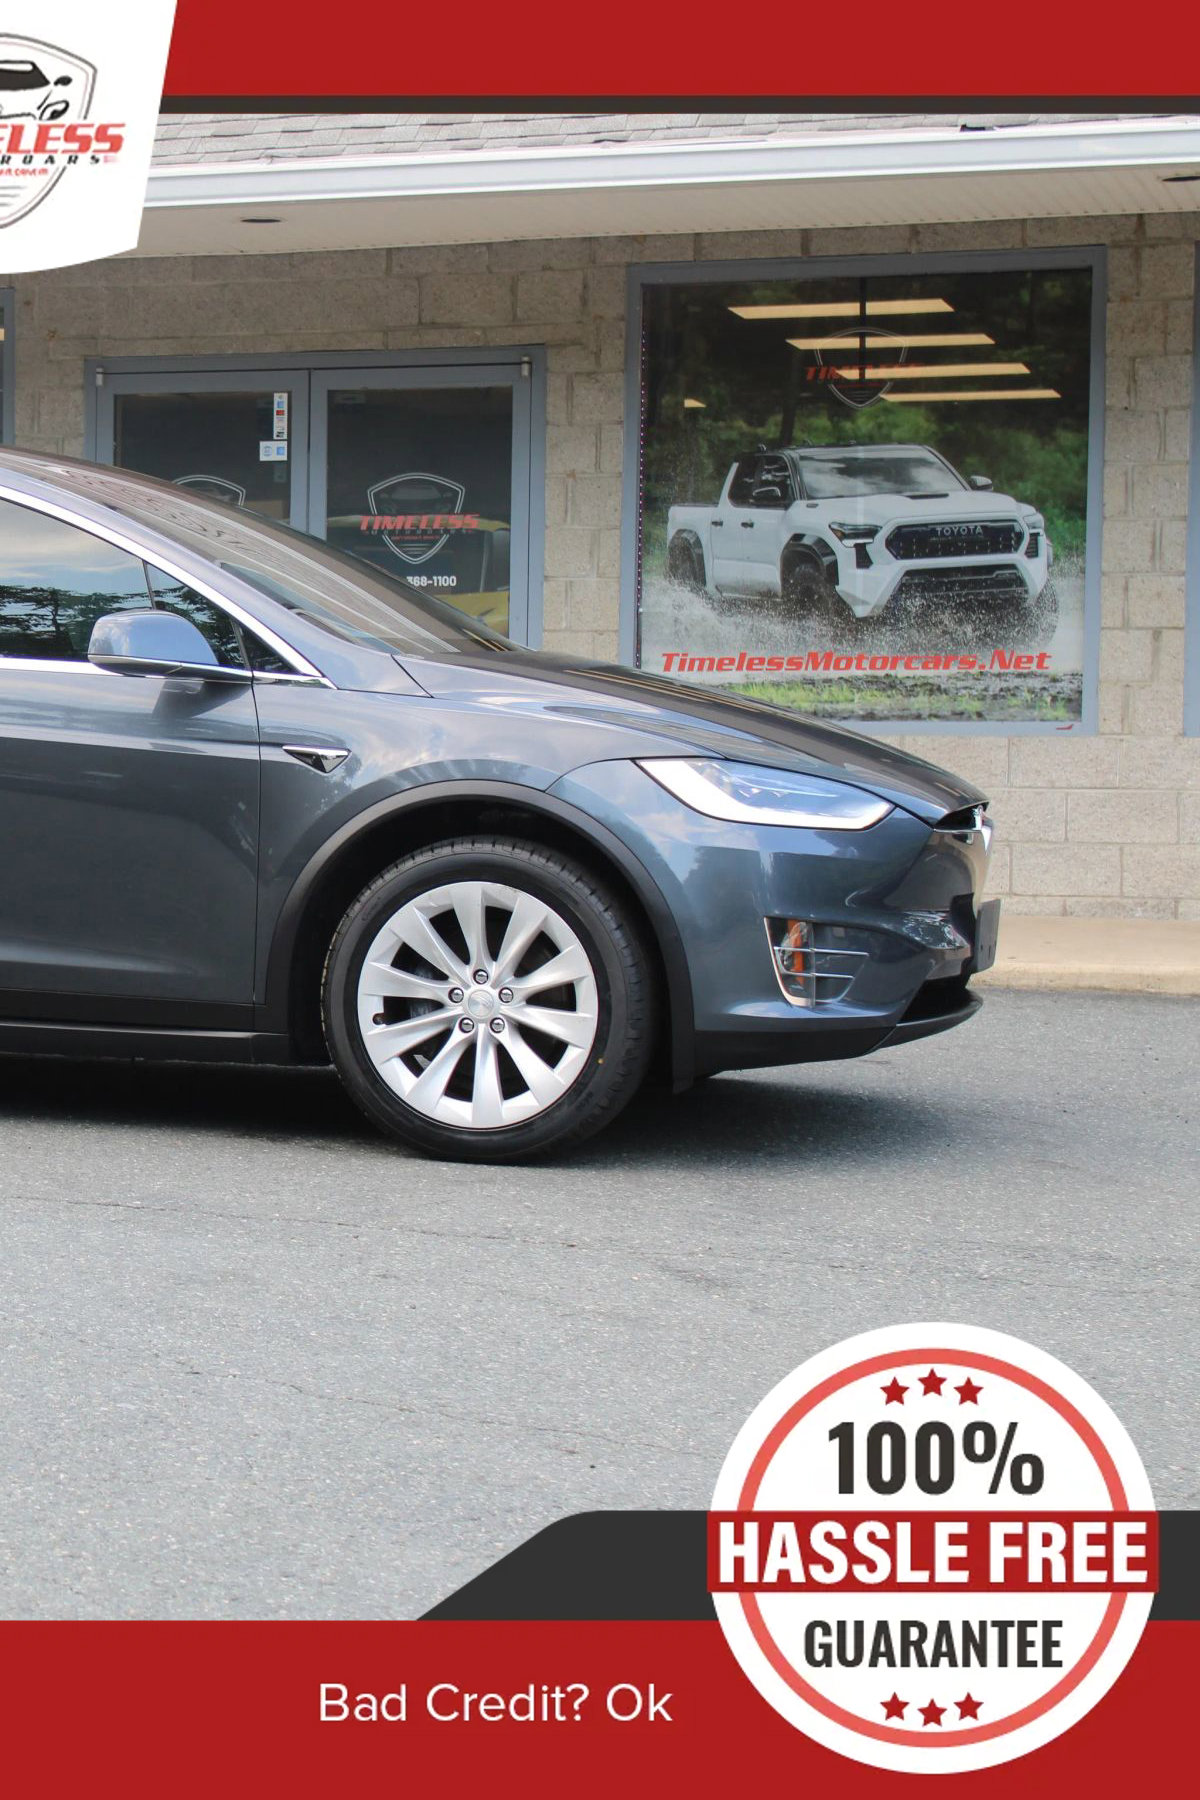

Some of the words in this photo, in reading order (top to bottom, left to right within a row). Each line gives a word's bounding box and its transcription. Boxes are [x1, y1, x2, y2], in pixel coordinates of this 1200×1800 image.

[359, 513, 480, 531] TIMELESS
[936, 526, 984, 536] TOYOTA
[661, 650, 1052, 673] TimelessMotorcars.Net
